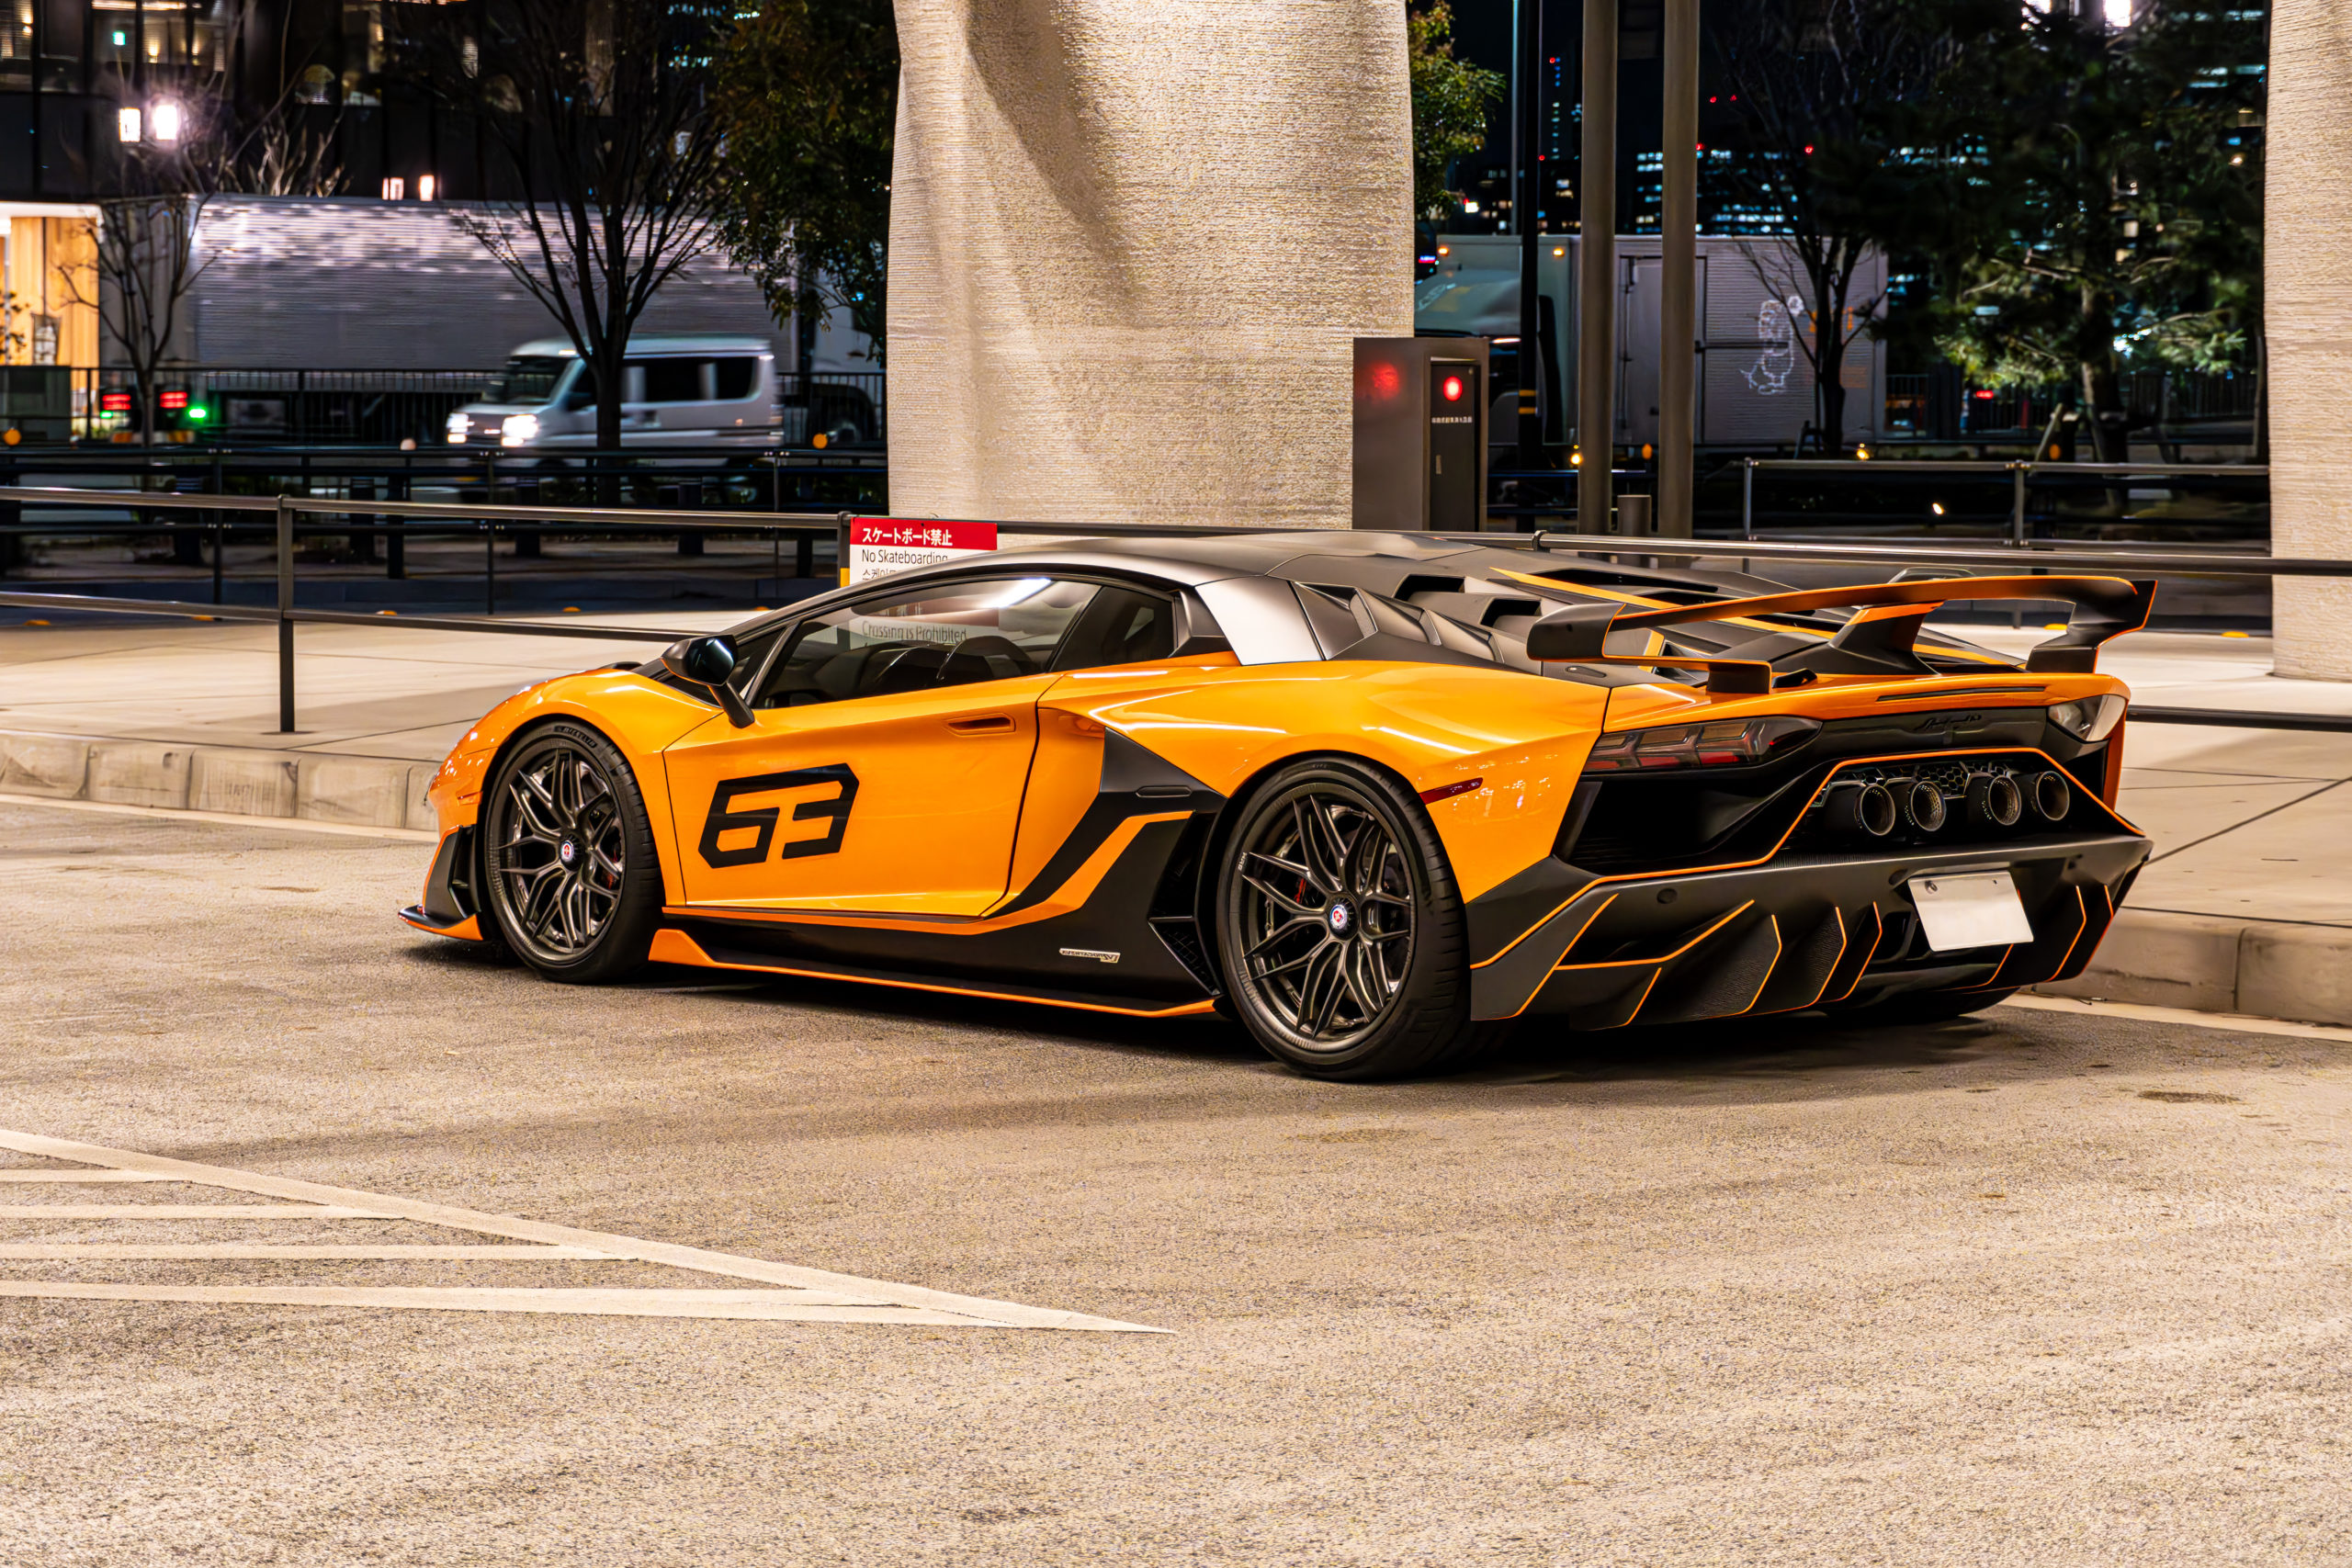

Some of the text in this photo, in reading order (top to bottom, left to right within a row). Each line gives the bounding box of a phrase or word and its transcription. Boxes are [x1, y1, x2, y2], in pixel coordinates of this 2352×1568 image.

[862, 527, 953, 546] スケートボード禁止
[862, 548, 876, 563] No
[698, 762, 860, 869] 63
